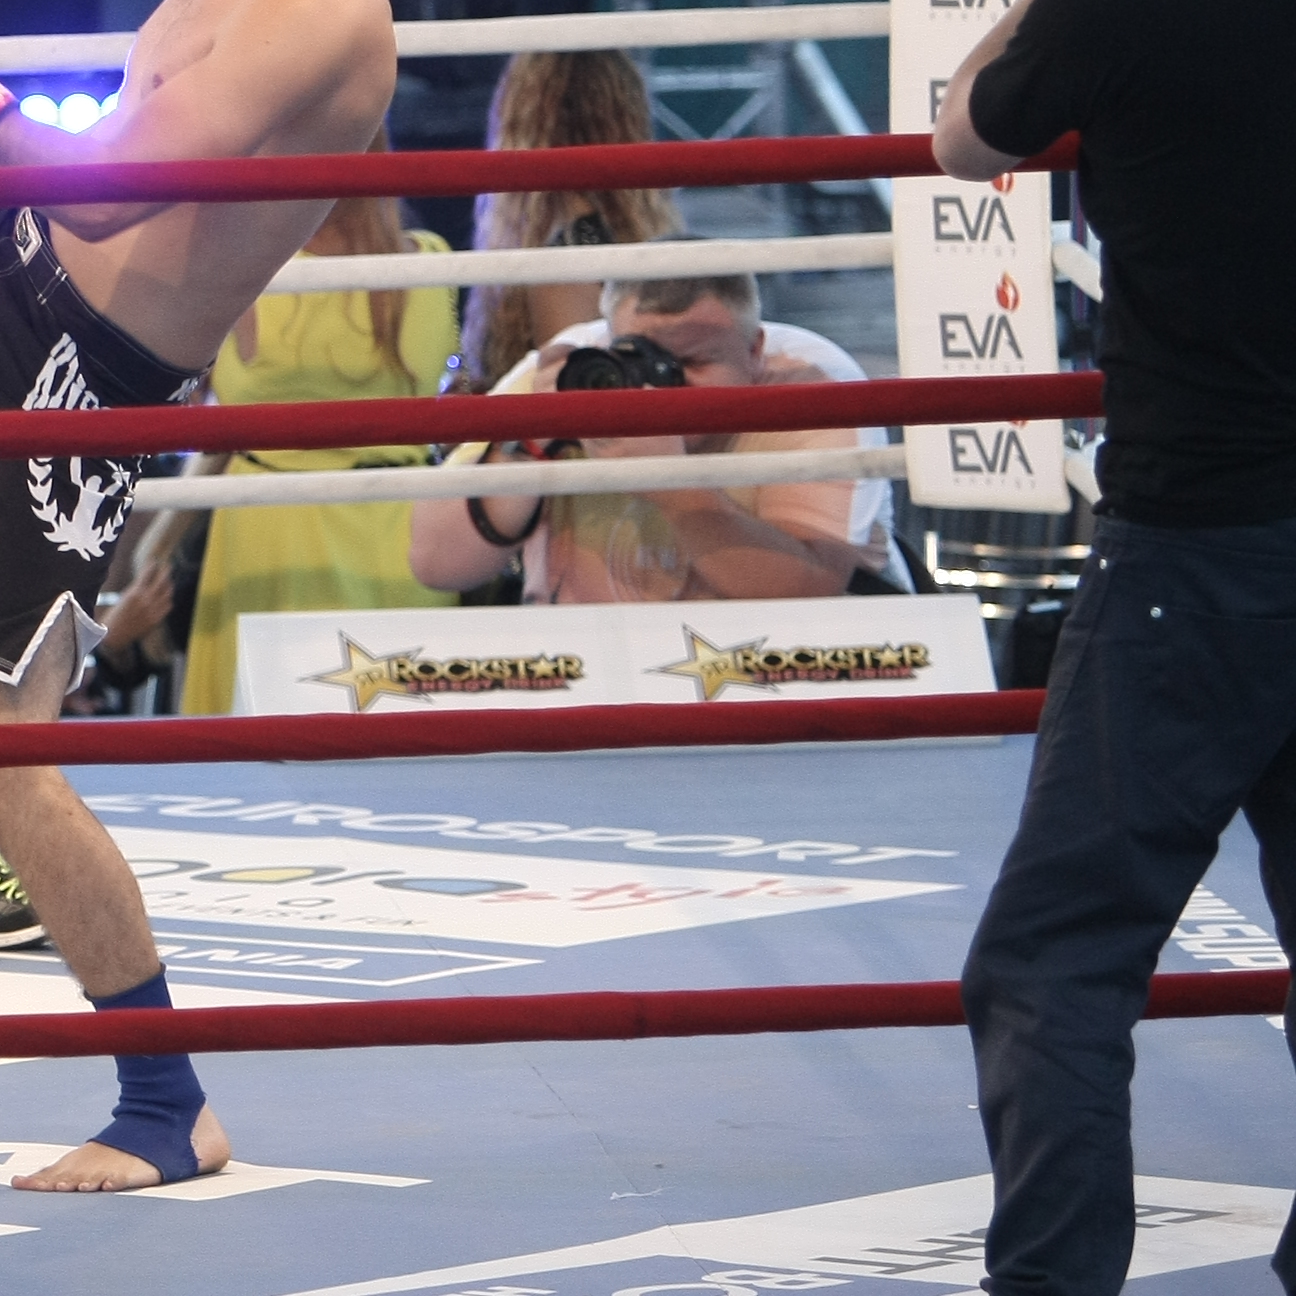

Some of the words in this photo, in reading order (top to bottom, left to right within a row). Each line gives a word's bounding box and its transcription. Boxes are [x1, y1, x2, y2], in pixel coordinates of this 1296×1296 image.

[933, 195, 1016, 242] EVA
[939, 313, 1023, 360] EVA
[948, 428, 1034, 475] EVA
